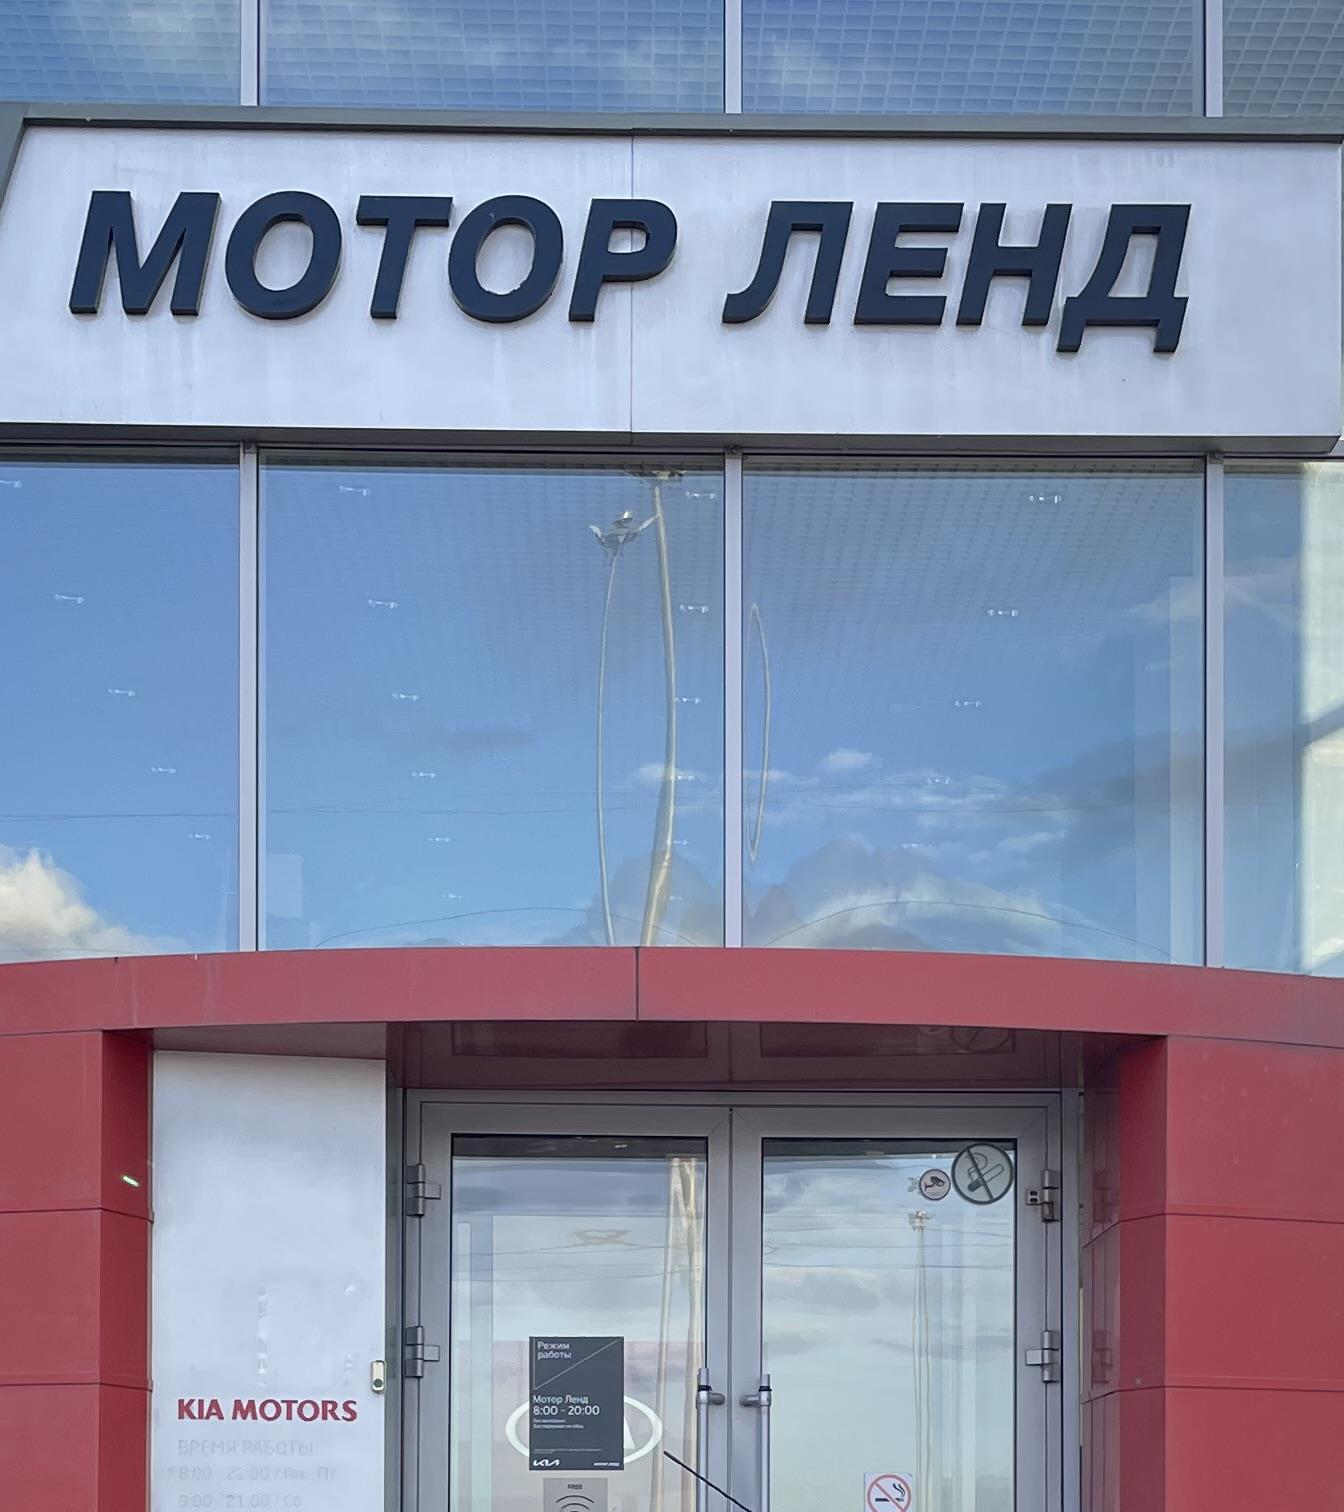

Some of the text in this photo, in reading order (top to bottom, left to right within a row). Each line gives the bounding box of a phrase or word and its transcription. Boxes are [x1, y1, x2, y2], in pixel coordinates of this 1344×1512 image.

[69, 190, 1192, 353] МОТОР ЛЕНД
[537, 1341, 570, 1350] Режим
[537, 1351, 572, 1360] работы
[533, 1394, 589, 1405] Мотор Ленд
[177, 1398, 357, 1422] KIA MOTORS
[533, 1405, 558, 1416] 8:00
[568, 1405, 600, 1416] 20:00
